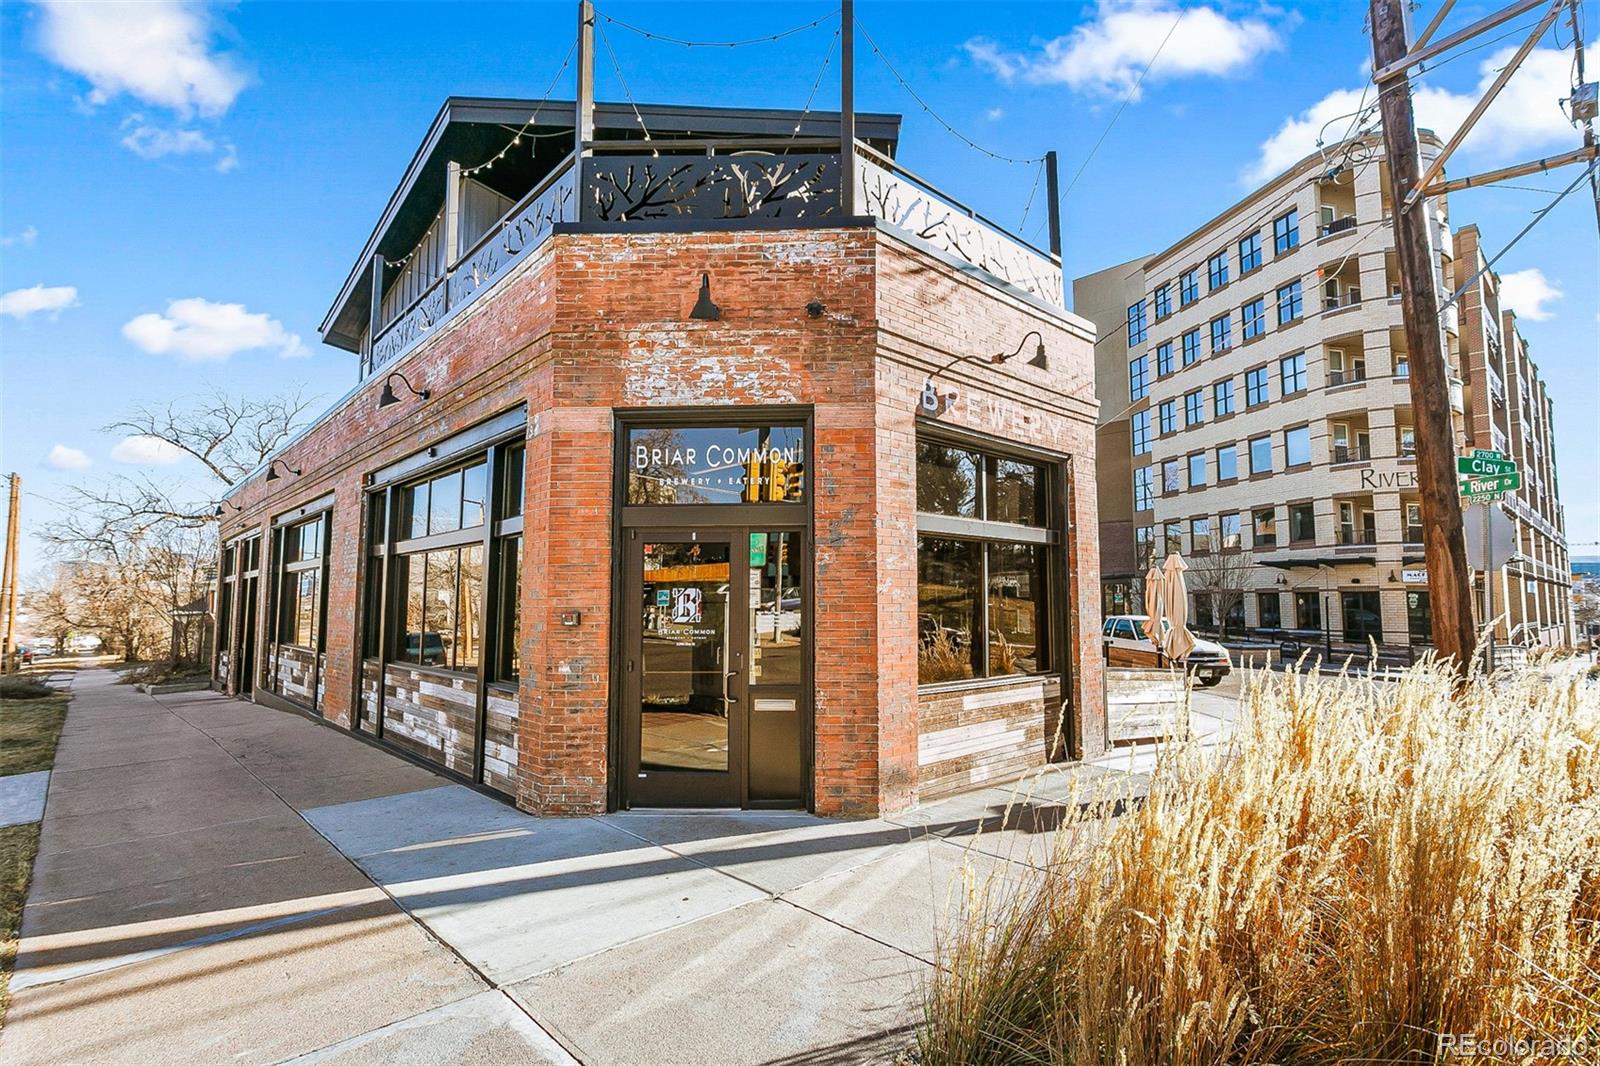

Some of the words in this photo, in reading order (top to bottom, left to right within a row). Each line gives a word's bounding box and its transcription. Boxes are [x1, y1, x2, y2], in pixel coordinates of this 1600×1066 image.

[921, 378, 1062, 444] BREWERY
[635, 445, 697, 469] BRIAR
[705, 444, 795, 468] COMMON
[1475, 451, 1494, 459] 2700
[1472, 460, 1500, 475] Clay
[658, 477, 711, 487] BREWERY
[728, 477, 771, 486] EATERY
[1360, 468, 1420, 490] RIVER
[1470, 480, 1500, 494] River
[1504, 478, 1513, 486] Dr
[1472, 494, 1492, 503] 2250
[1493, 493, 1501, 501] N
[657, 628, 681, 637] BRIAR
[683, 628, 716, 636] COMMON
